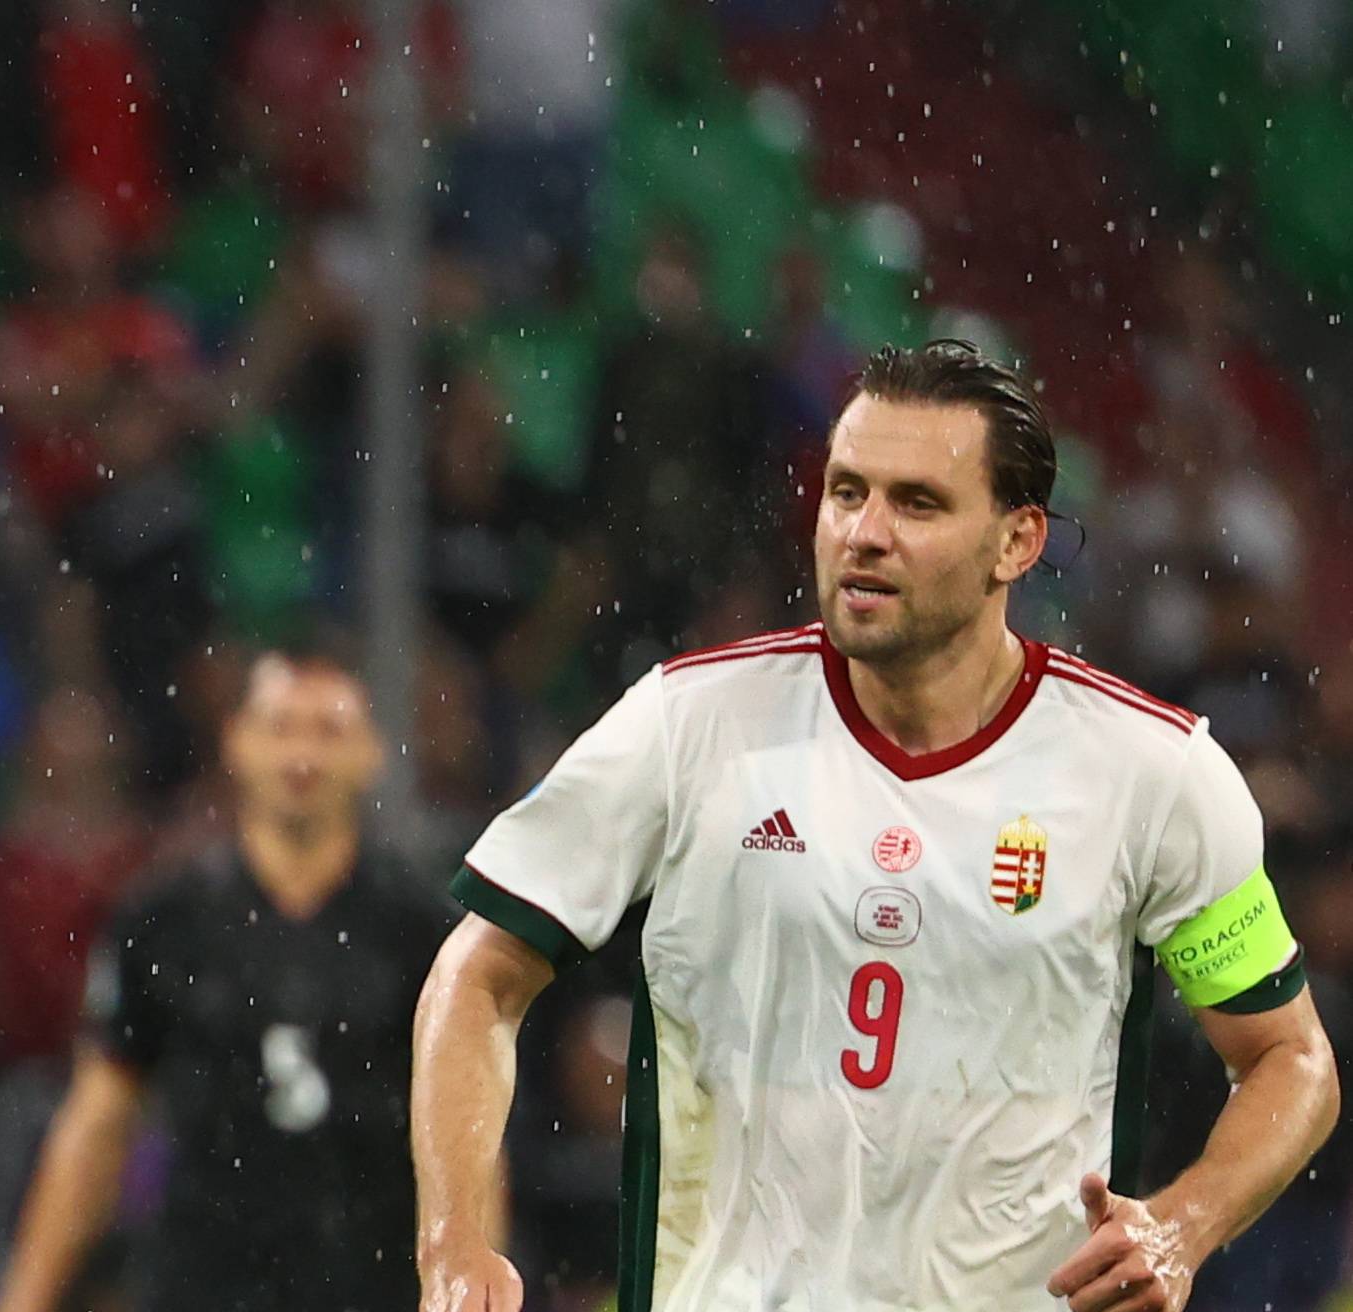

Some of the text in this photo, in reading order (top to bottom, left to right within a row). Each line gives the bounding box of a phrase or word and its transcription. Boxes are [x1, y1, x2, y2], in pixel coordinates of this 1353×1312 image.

[742, 834, 806, 853] adidas
[1201, 899, 1267, 954] RACISM
[840, 960, 904, 1090] 9
